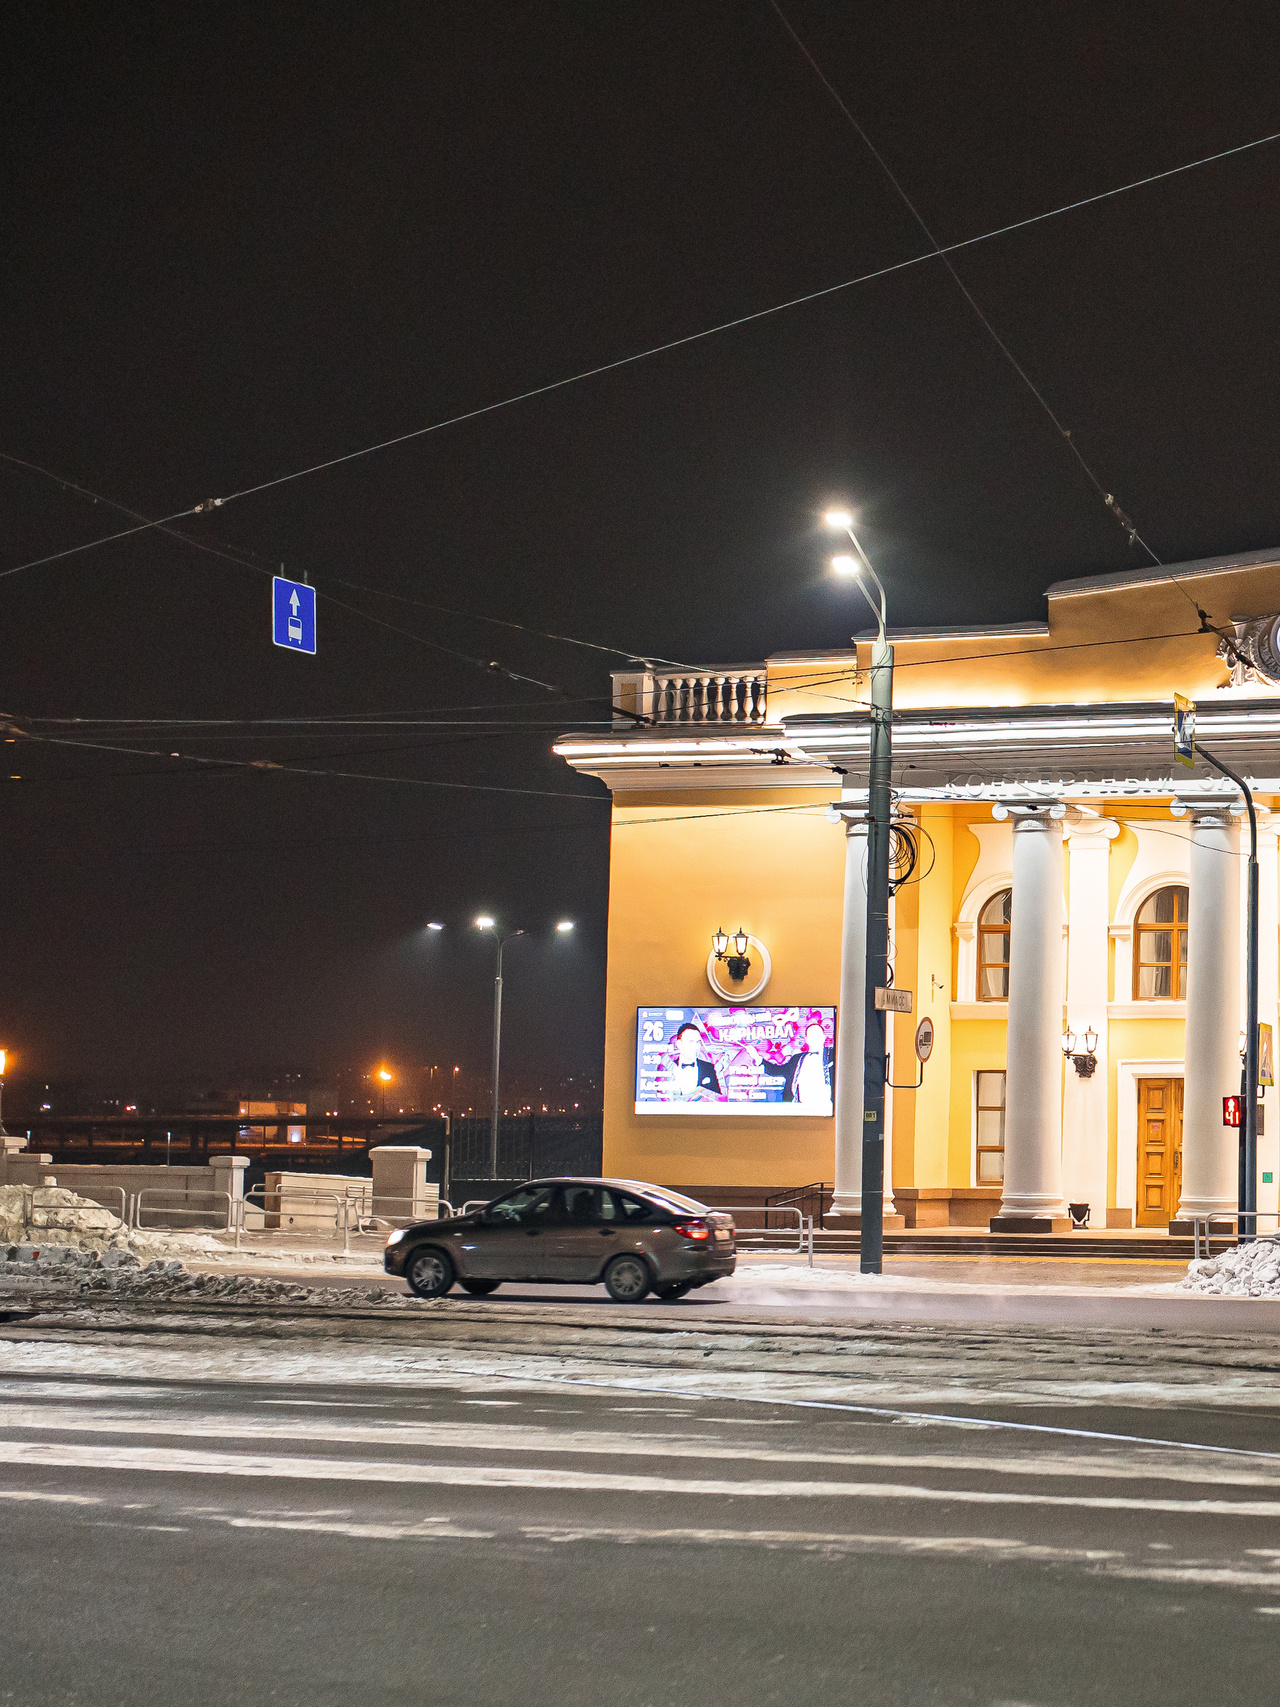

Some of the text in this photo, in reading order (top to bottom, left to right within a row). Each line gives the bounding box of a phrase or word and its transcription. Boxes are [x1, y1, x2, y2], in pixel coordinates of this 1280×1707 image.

[944, 766, 1175, 798] КОНЦЕРТНЫЙ
[1198, 764, 1259, 792] ЗАЛ
[642, 1020, 664, 1041] 26
[718, 1024, 794, 1042] КАРНАВАЛ
[1226, 1111, 1239, 1125] 41
